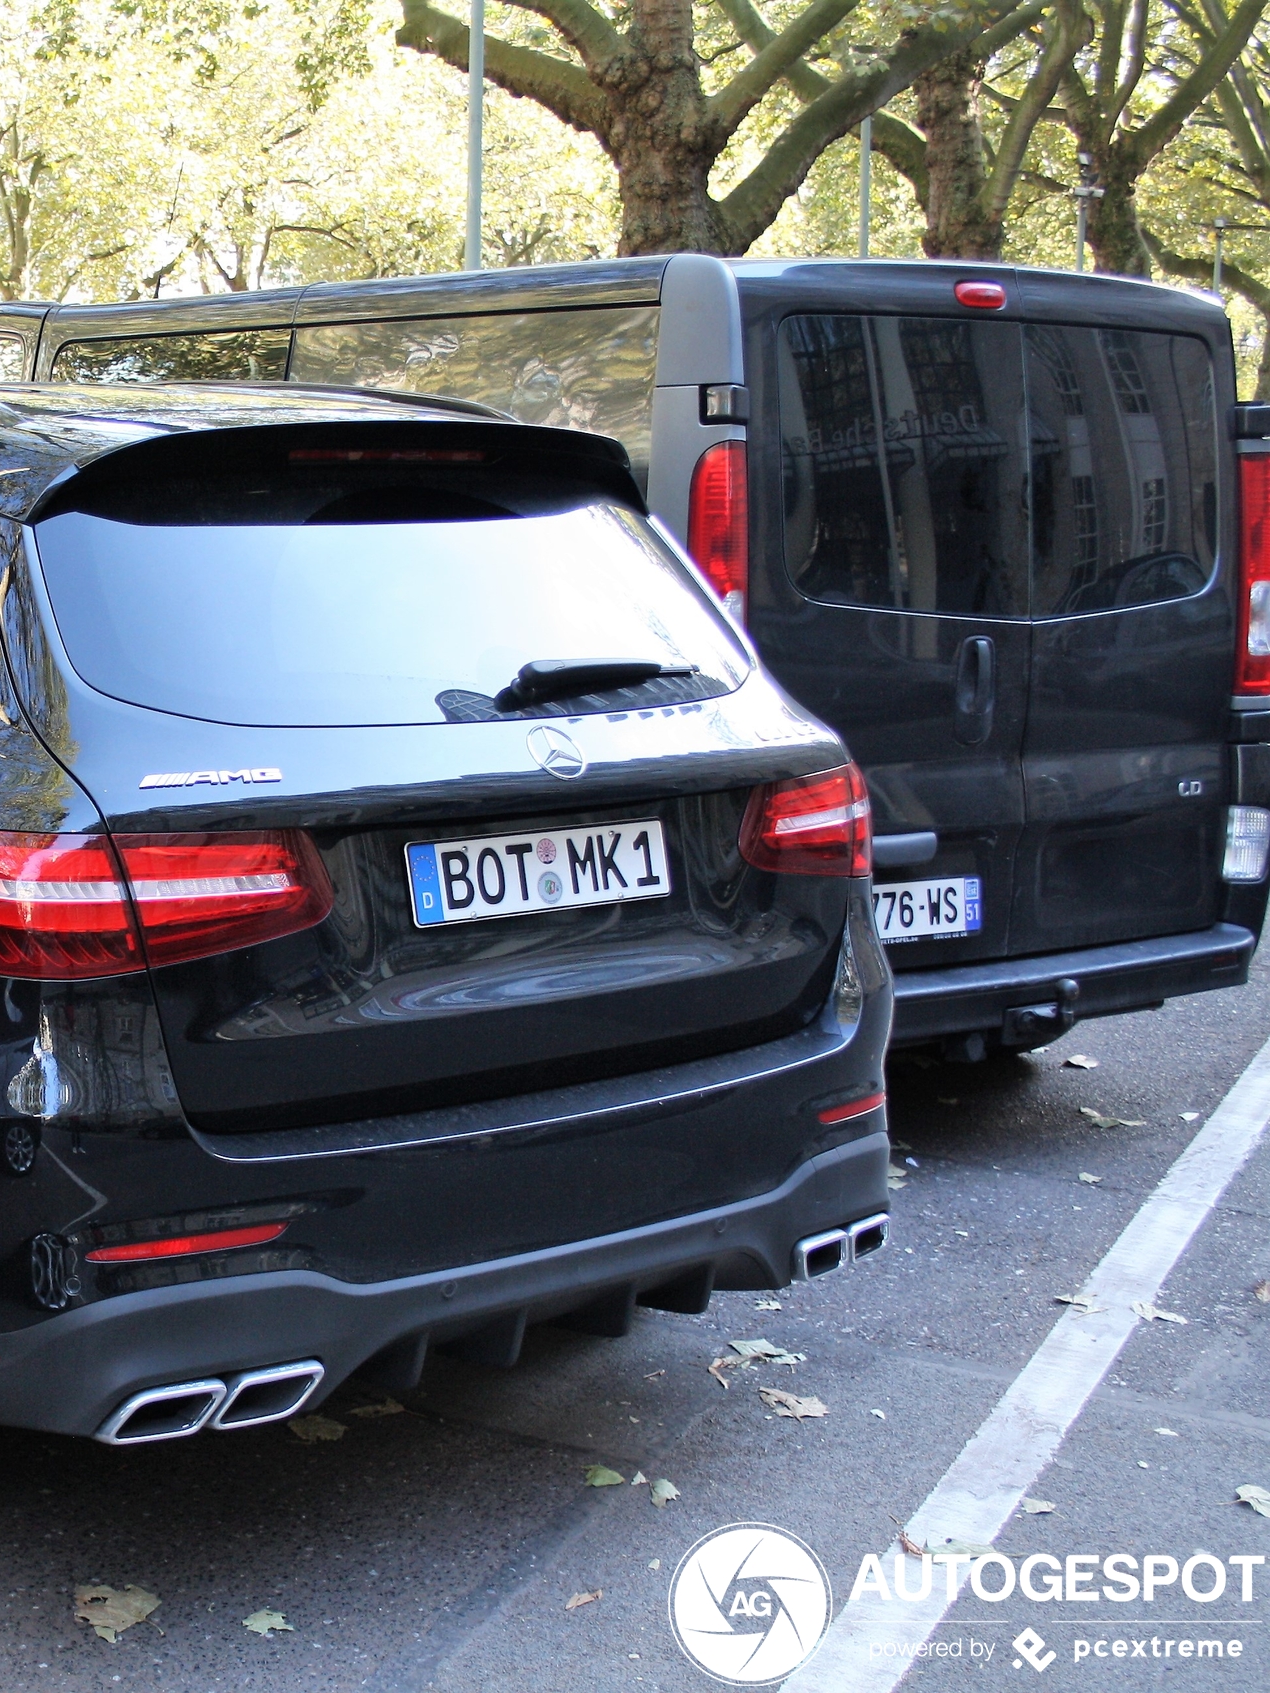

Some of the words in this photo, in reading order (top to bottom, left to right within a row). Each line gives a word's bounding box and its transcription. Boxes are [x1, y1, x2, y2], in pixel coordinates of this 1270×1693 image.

[186, 767, 283, 786] AMG
[422, 892, 435, 909] D
[441, 842, 534, 910] BOT
[966, 903, 979, 921] 51
